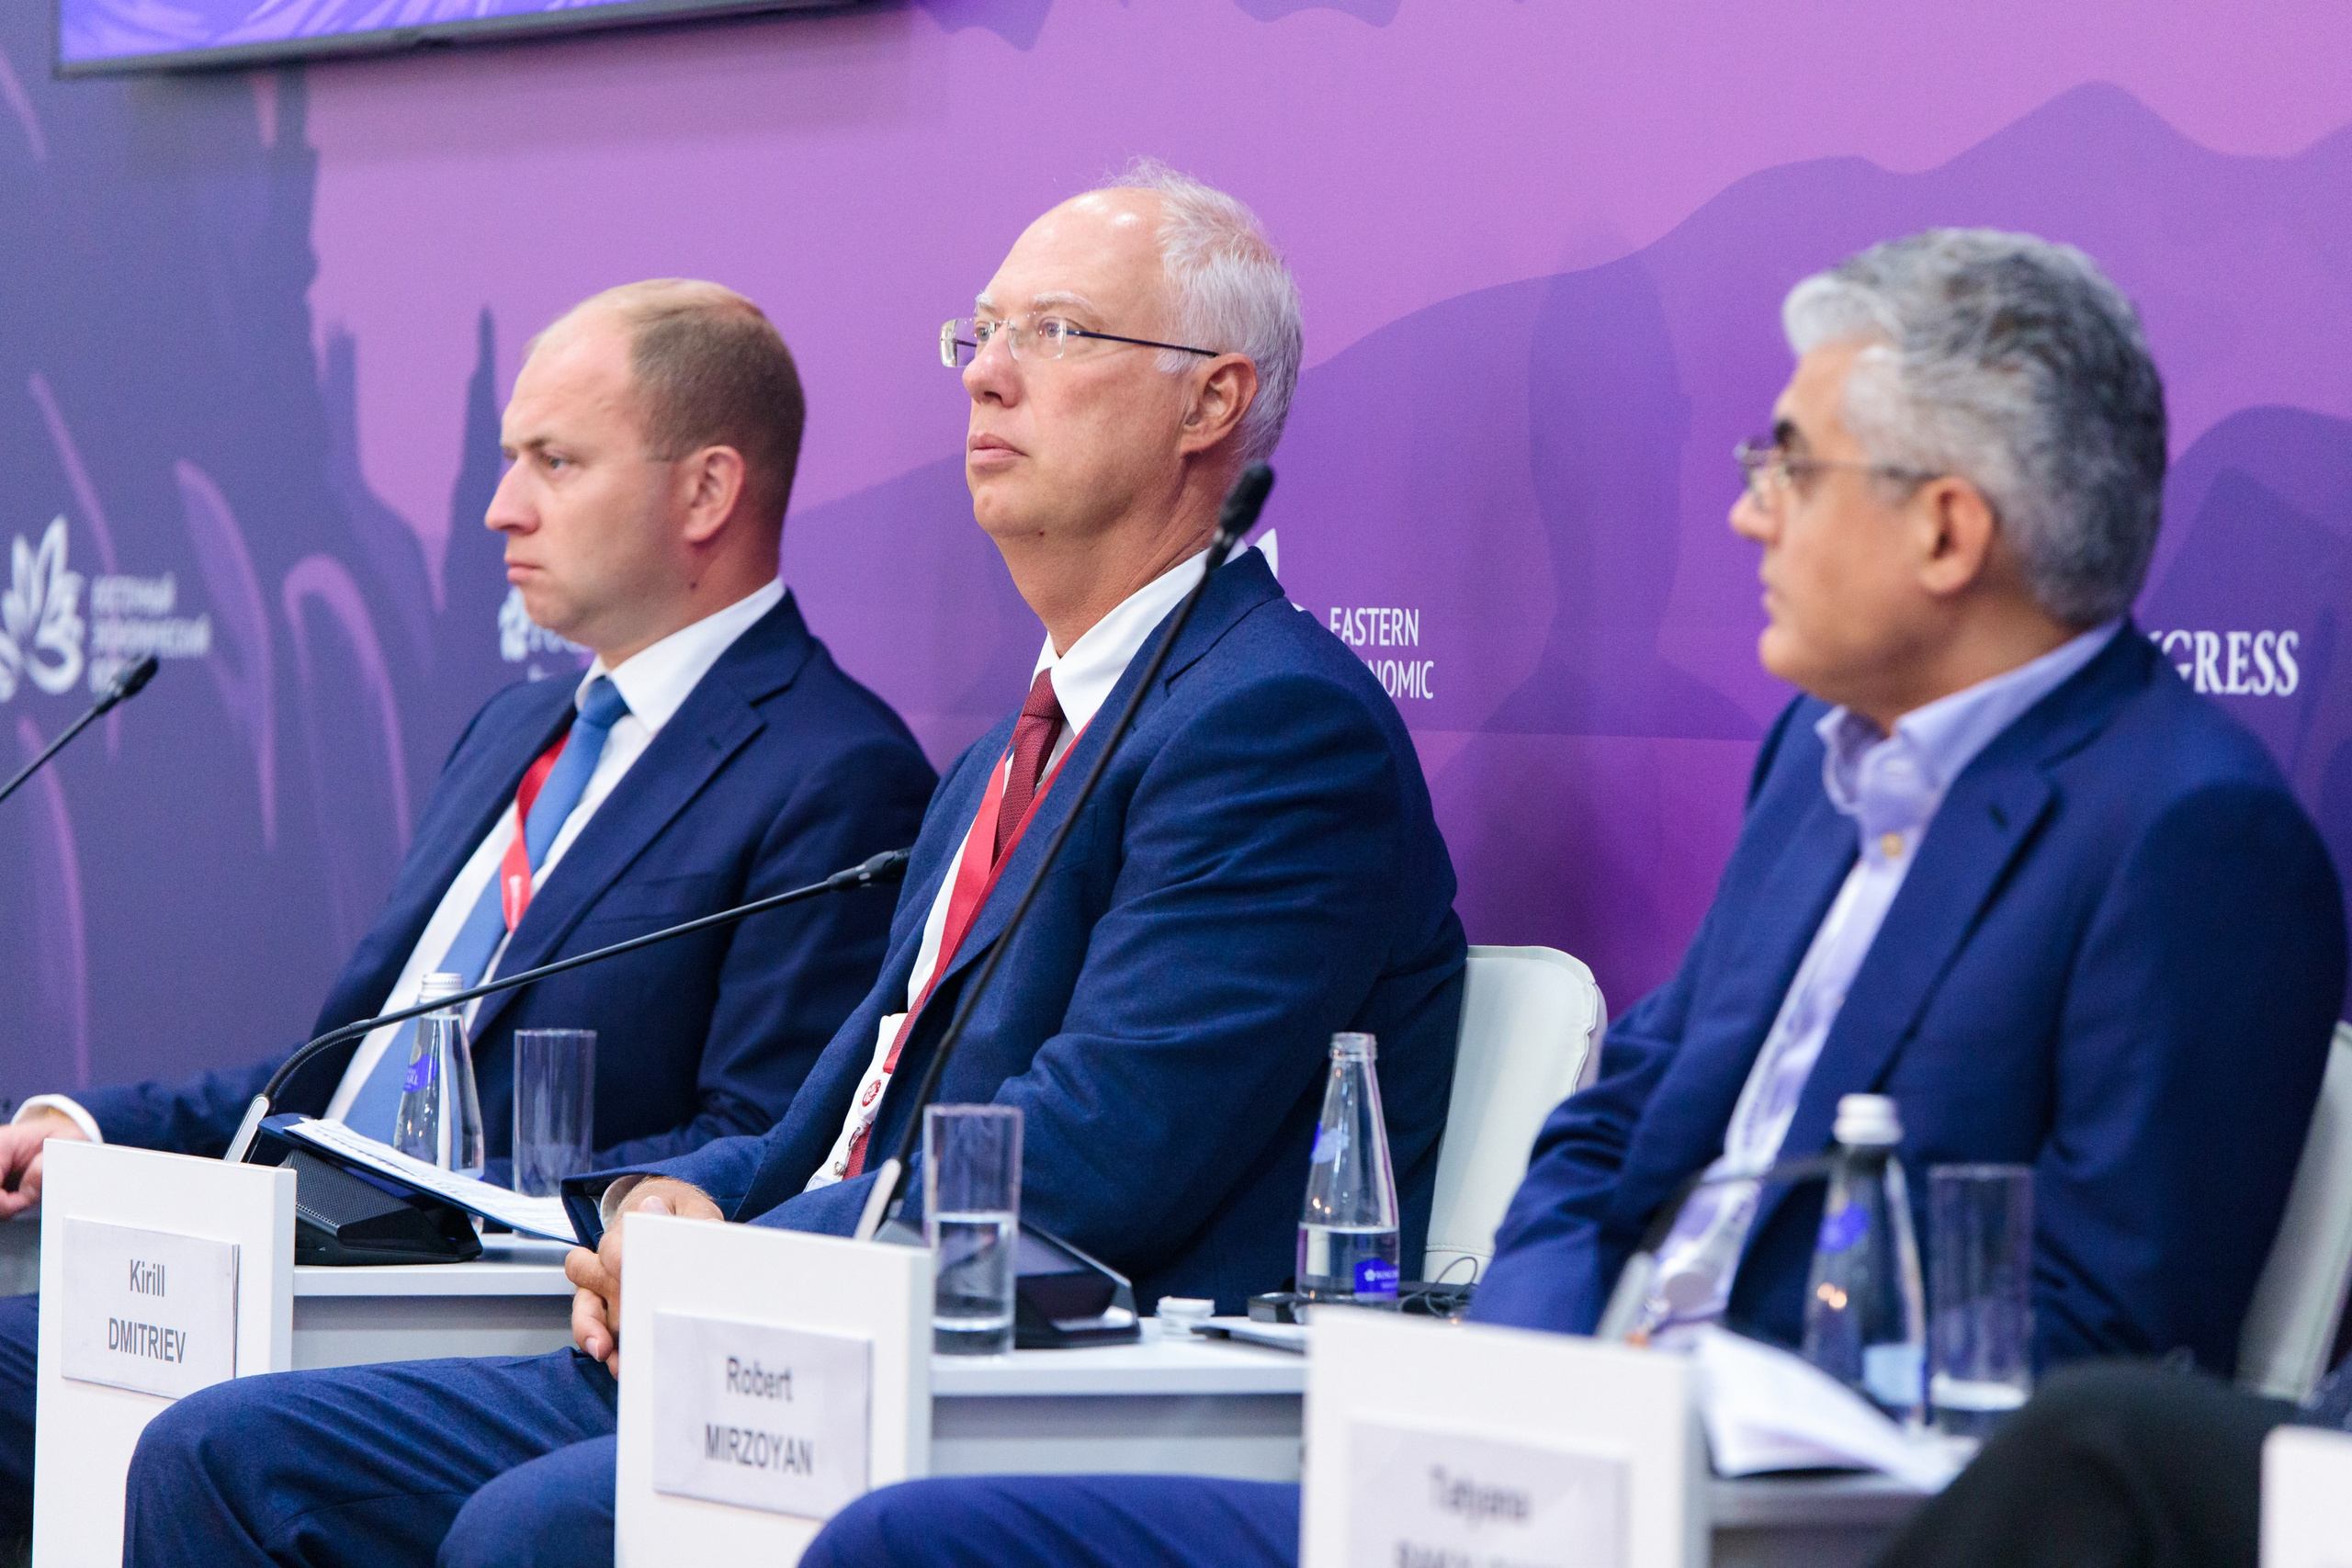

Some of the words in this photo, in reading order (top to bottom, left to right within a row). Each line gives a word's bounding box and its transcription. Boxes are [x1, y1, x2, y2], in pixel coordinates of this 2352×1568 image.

[1329, 607, 1419, 647] EASTERN
[1365, 660, 1434, 700] NOMIC
[2148, 629, 2300, 696] GRESS
[129, 1258, 165, 1298] Kirill
[107, 1316, 187, 1364] DMITRIEV
[726, 1355, 793, 1403] Robert
[704, 1422, 814, 1475] MIRZOYAN
